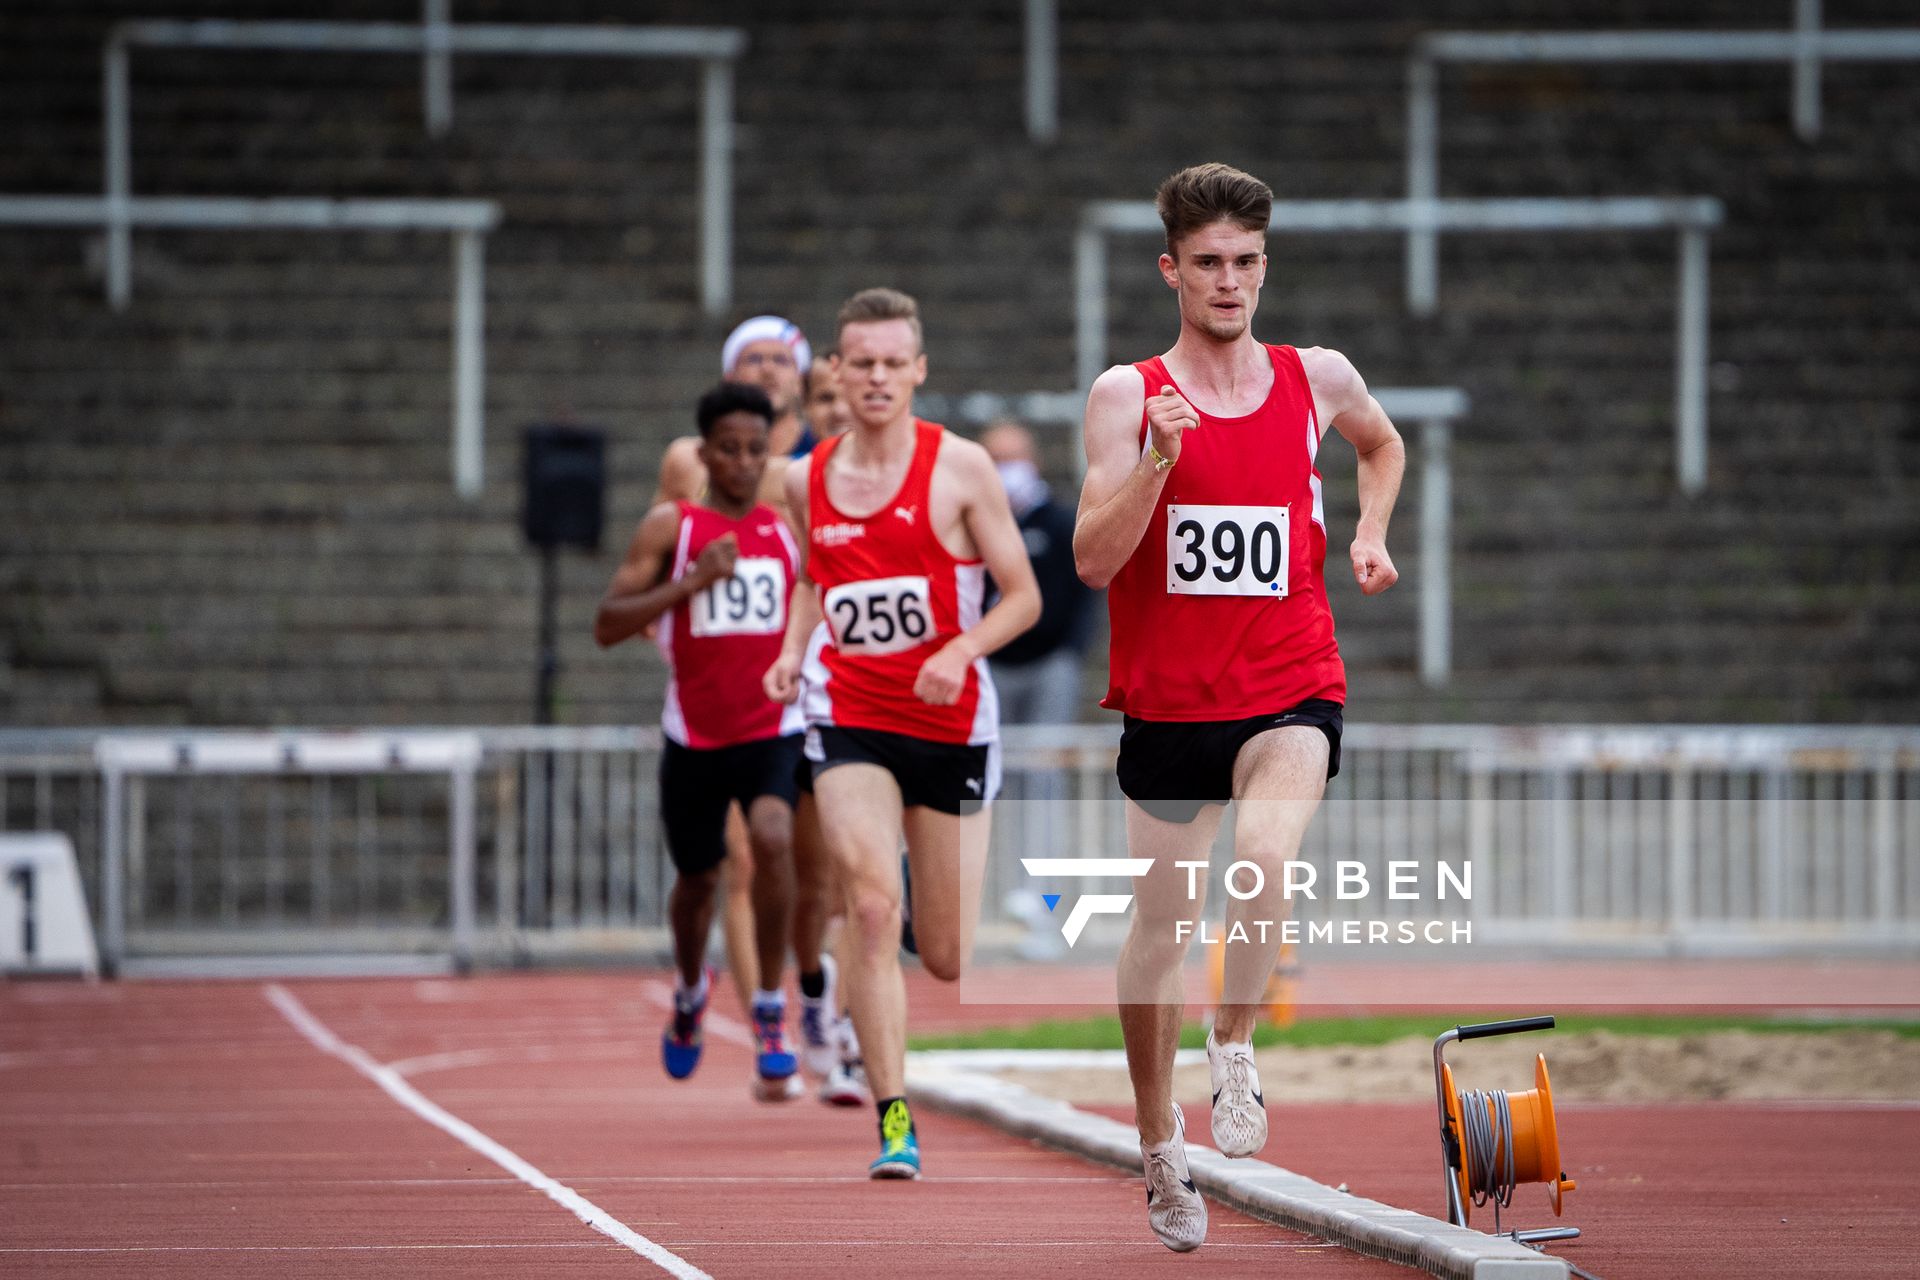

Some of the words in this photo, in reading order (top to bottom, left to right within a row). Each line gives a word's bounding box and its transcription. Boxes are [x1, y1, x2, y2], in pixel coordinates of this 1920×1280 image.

[1174, 519, 1282, 583] 390
[706, 574, 777, 621] 193
[834, 590, 927, 645] 256
[9, 863, 37, 955] 1
